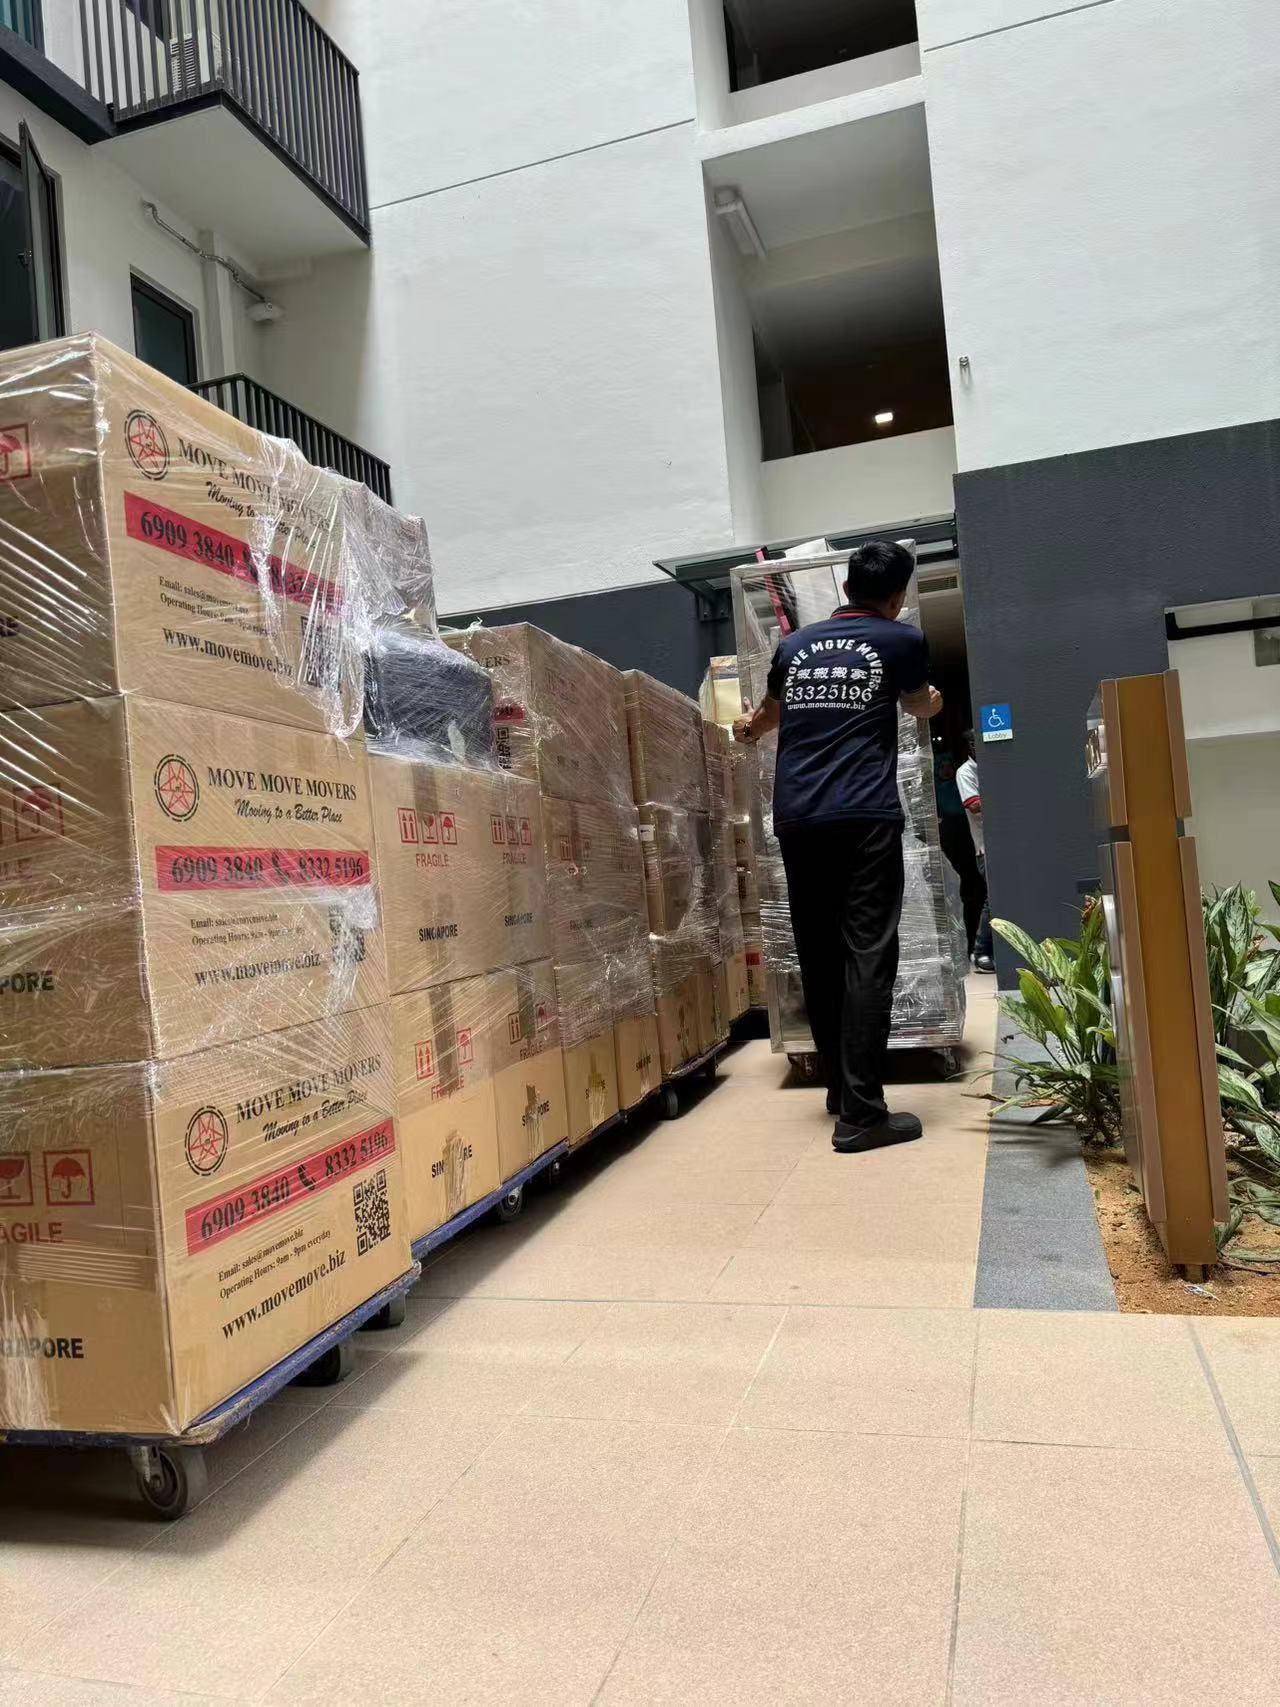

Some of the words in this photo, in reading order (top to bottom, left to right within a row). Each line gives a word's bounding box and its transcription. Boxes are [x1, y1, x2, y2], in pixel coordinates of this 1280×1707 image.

[177, 437, 229, 480] MOVE
[206, 481, 244, 517] Moving
[141, 512, 187, 548] 6909
[193, 531, 234, 568] 3840
[159, 576, 182, 593] Email:
[160, 592, 196, 614] Operating
[785, 649, 809, 687] MOVE
[810, 639, 856, 654] MOVE
[856, 642, 884, 691] MOVERS
[785, 684, 872, 703] 83325196
[787, 701, 866, 711] www.movemove.biz
[207, 766, 257, 791] MOVE
[260, 773, 303, 796] MOVE
[306, 779, 357, 801] MOVERS
[234, 798, 272, 823] Moving
[275, 805, 283, 819] to
[294, 803, 319, 821] Better
[320, 806, 343, 823] Place
[171, 855, 218, 883] 6909
[223, 856, 264, 883] 3840
[299, 855, 331, 881] 8332
[334, 856, 363, 881] 5196
[416, 853, 449, 868] FRAGILE
[418, 924, 458, 942] SINGAPORE
[236, 1088, 285, 1123] MOVE
[288, 1072, 331, 1104] MOVE
[333, 1054, 382, 1086] MOVERS
[262, 1120, 300, 1142] Moving
[302, 1115, 311, 1126] to
[321, 1100, 345, 1119] Better
[201, 1198, 245, 1241] 6909
[251, 1176, 291, 1216] 3840
[324, 1144, 357, 1179] 8332
[359, 1131, 388, 1162] 5196
[218, 1263, 241, 1282] Email:
[242, 1227, 304, 1270] sales@movemove.biz
[219, 1275, 253, 1299] Operating
[307, 1229, 331, 1249] everyday
[222, 1249, 346, 1340] www.movemove.biz
